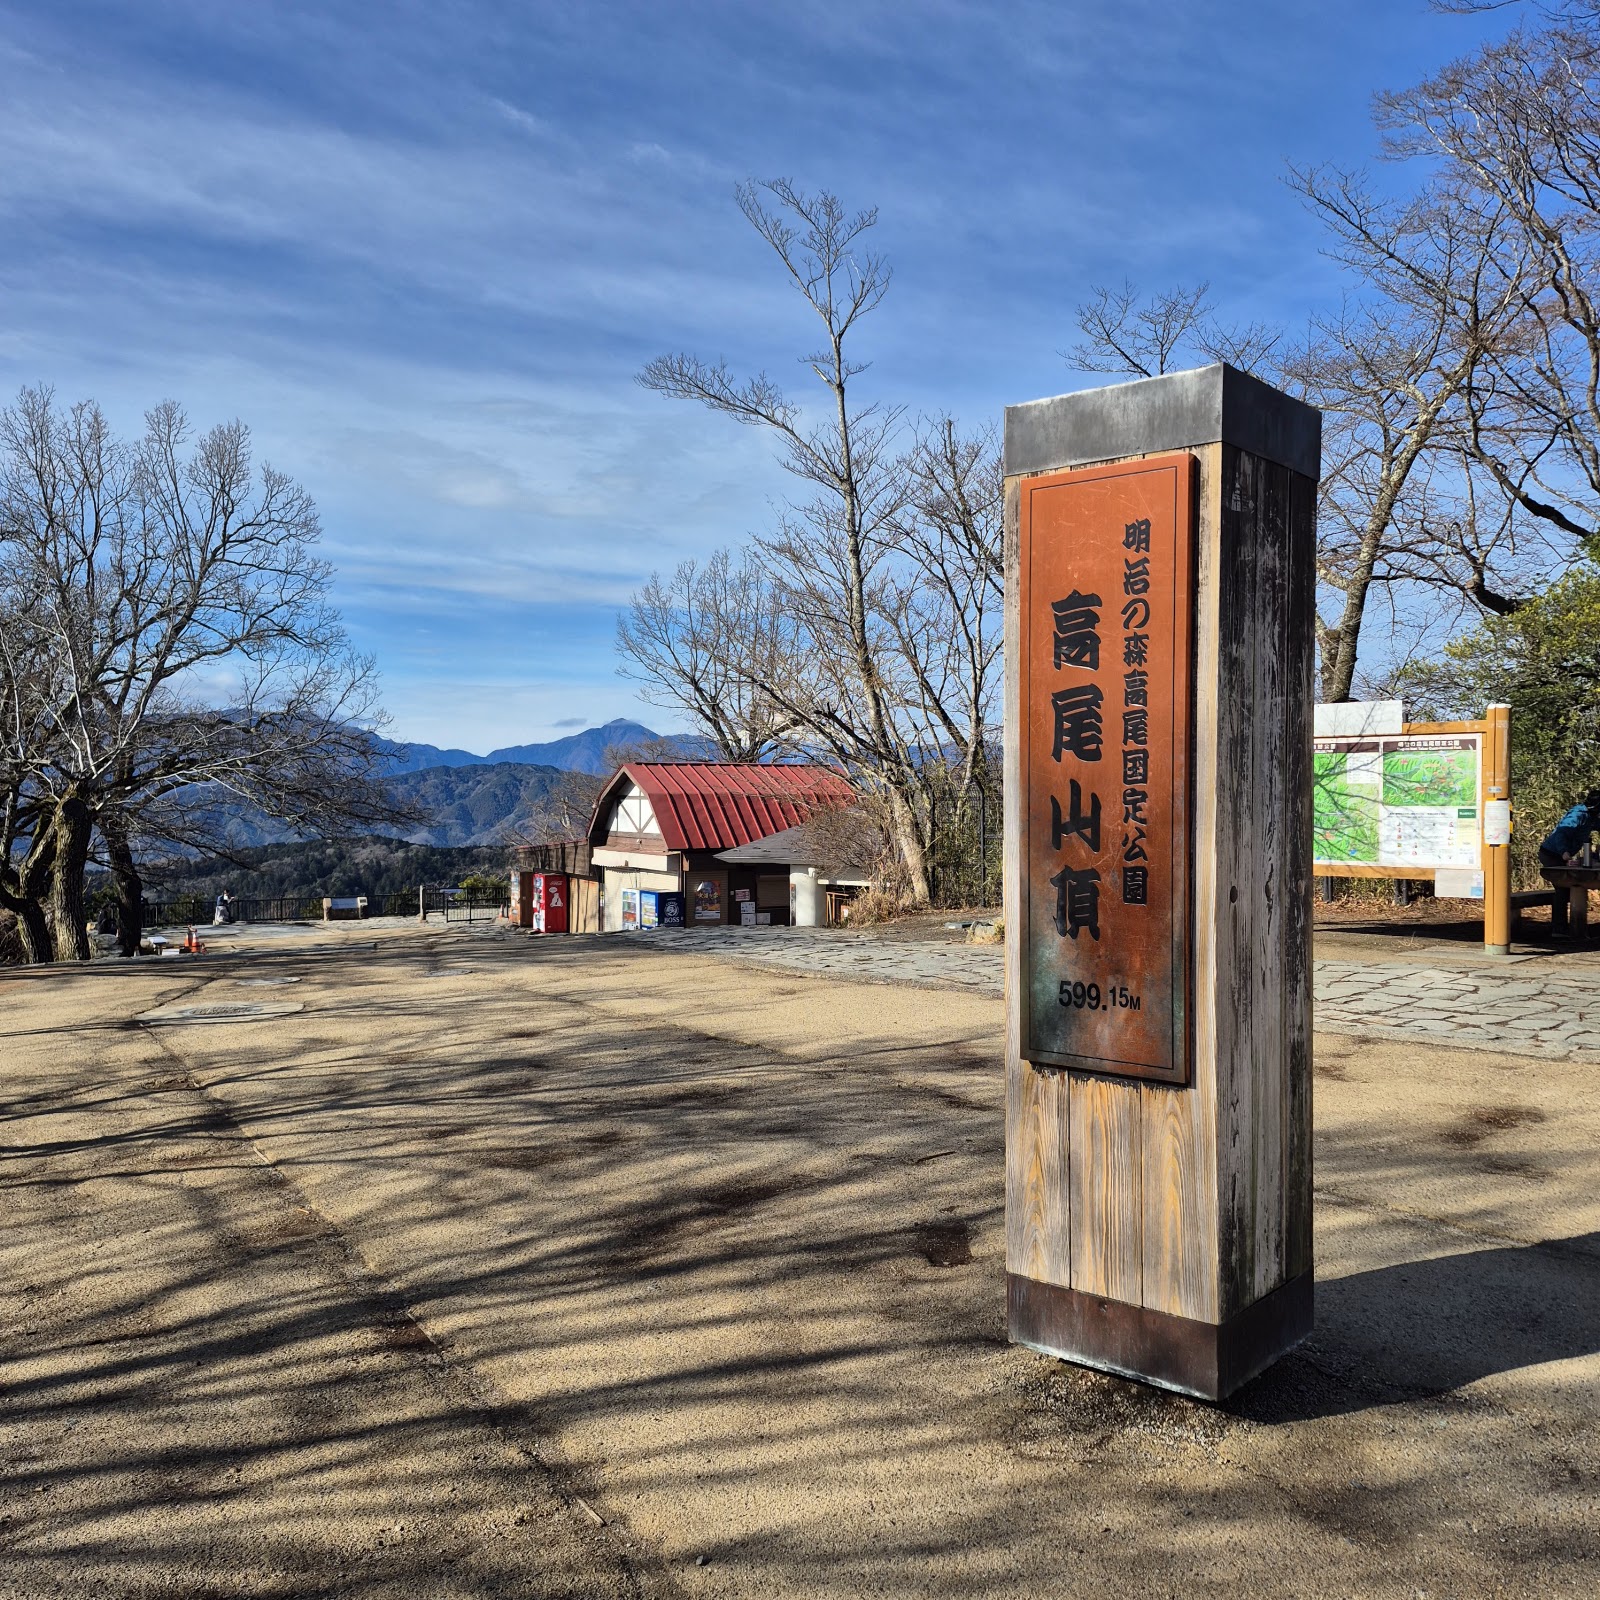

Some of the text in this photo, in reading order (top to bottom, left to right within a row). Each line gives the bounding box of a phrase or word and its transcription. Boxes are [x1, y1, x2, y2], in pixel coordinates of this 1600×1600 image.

[1050, 589, 1104, 941] 高尾山頂
[1121, 518, 1151, 906] 明治の森高尾国定公園
[1059, 980, 1141, 1011] 599.15M
